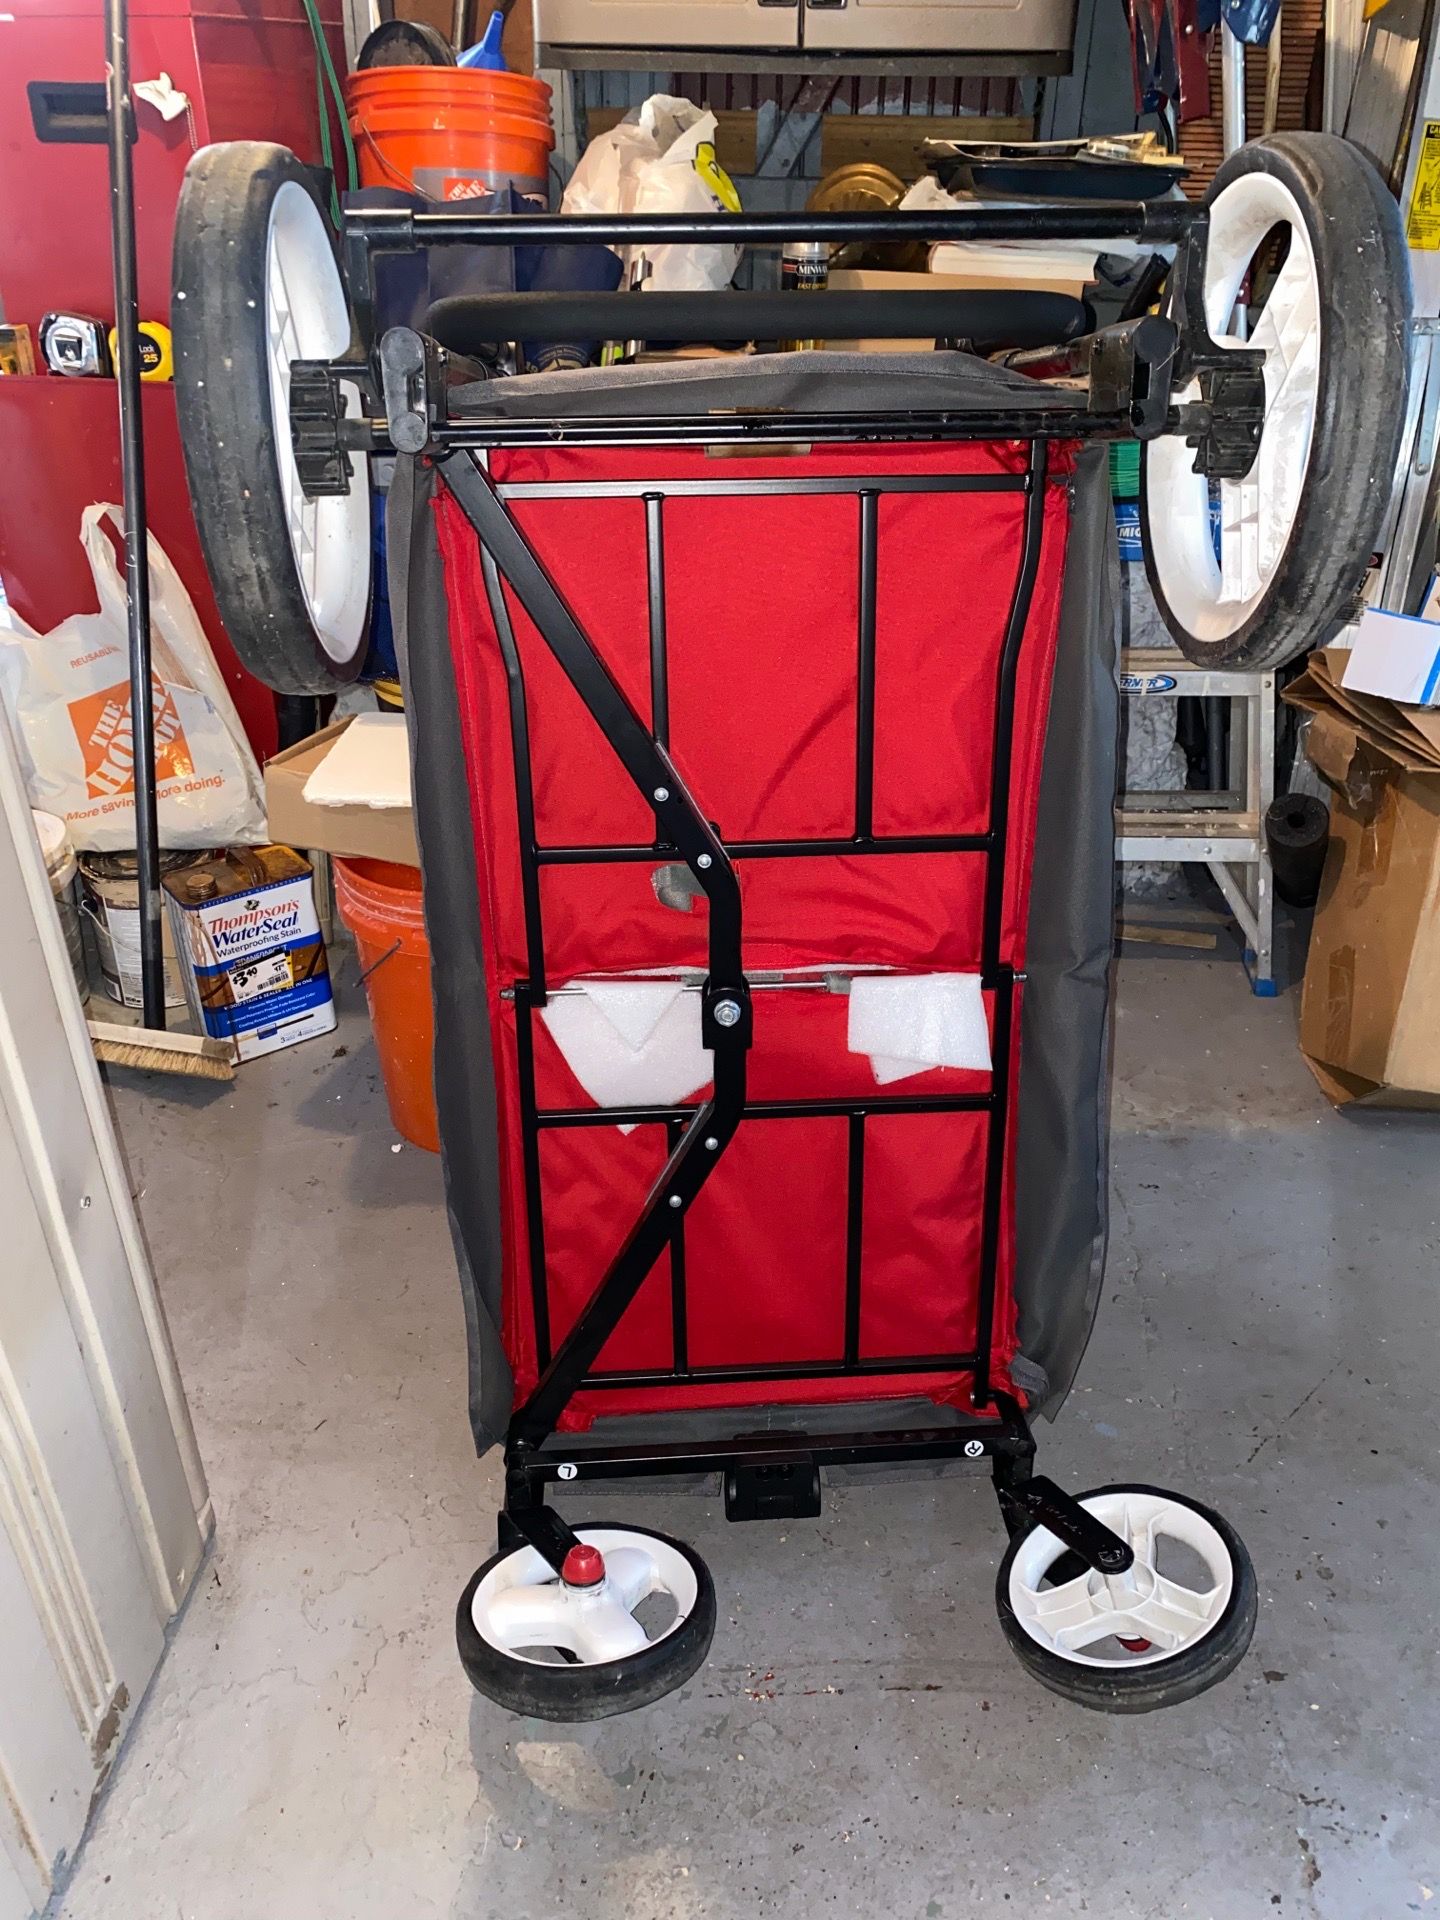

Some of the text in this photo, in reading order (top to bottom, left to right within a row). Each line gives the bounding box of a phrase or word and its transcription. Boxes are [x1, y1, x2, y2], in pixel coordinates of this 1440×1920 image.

[143, 354, 158, 363] 25
[88, 699, 124, 749] THE
[66, 808, 100, 820] More
[102, 799, 136, 814] savin
[184, 774, 225, 793] doing.
[208, 899, 299, 934] Thompson's
[212, 911, 298, 948] WaterSeal
[216, 927, 302, 958] Waterproofing Stain
[967, 1441, 982, 1455] R
